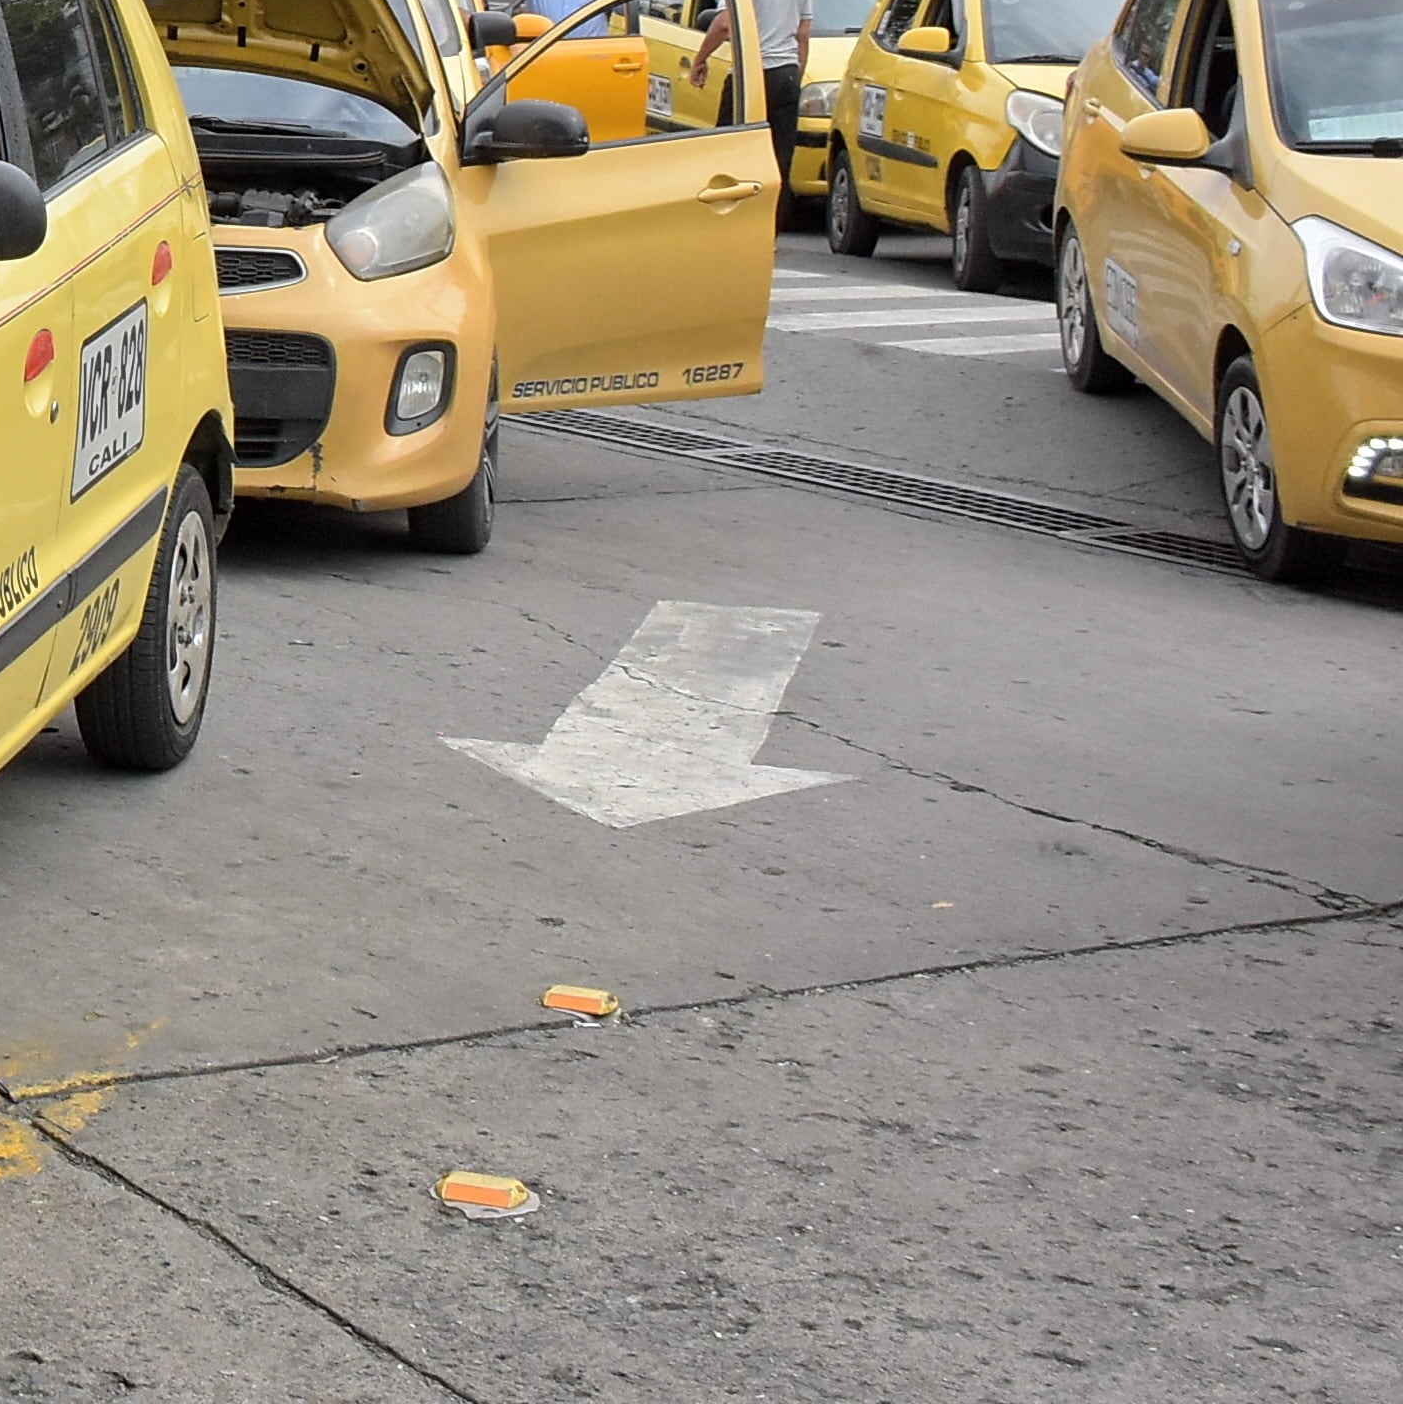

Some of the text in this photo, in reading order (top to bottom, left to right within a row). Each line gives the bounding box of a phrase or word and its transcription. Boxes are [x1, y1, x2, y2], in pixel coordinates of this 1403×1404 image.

[512, 362, 744, 398] SERVICIO PUBLICO 16287
[88, 430, 128, 477] CALI
[68, 577, 120, 677] 2909
